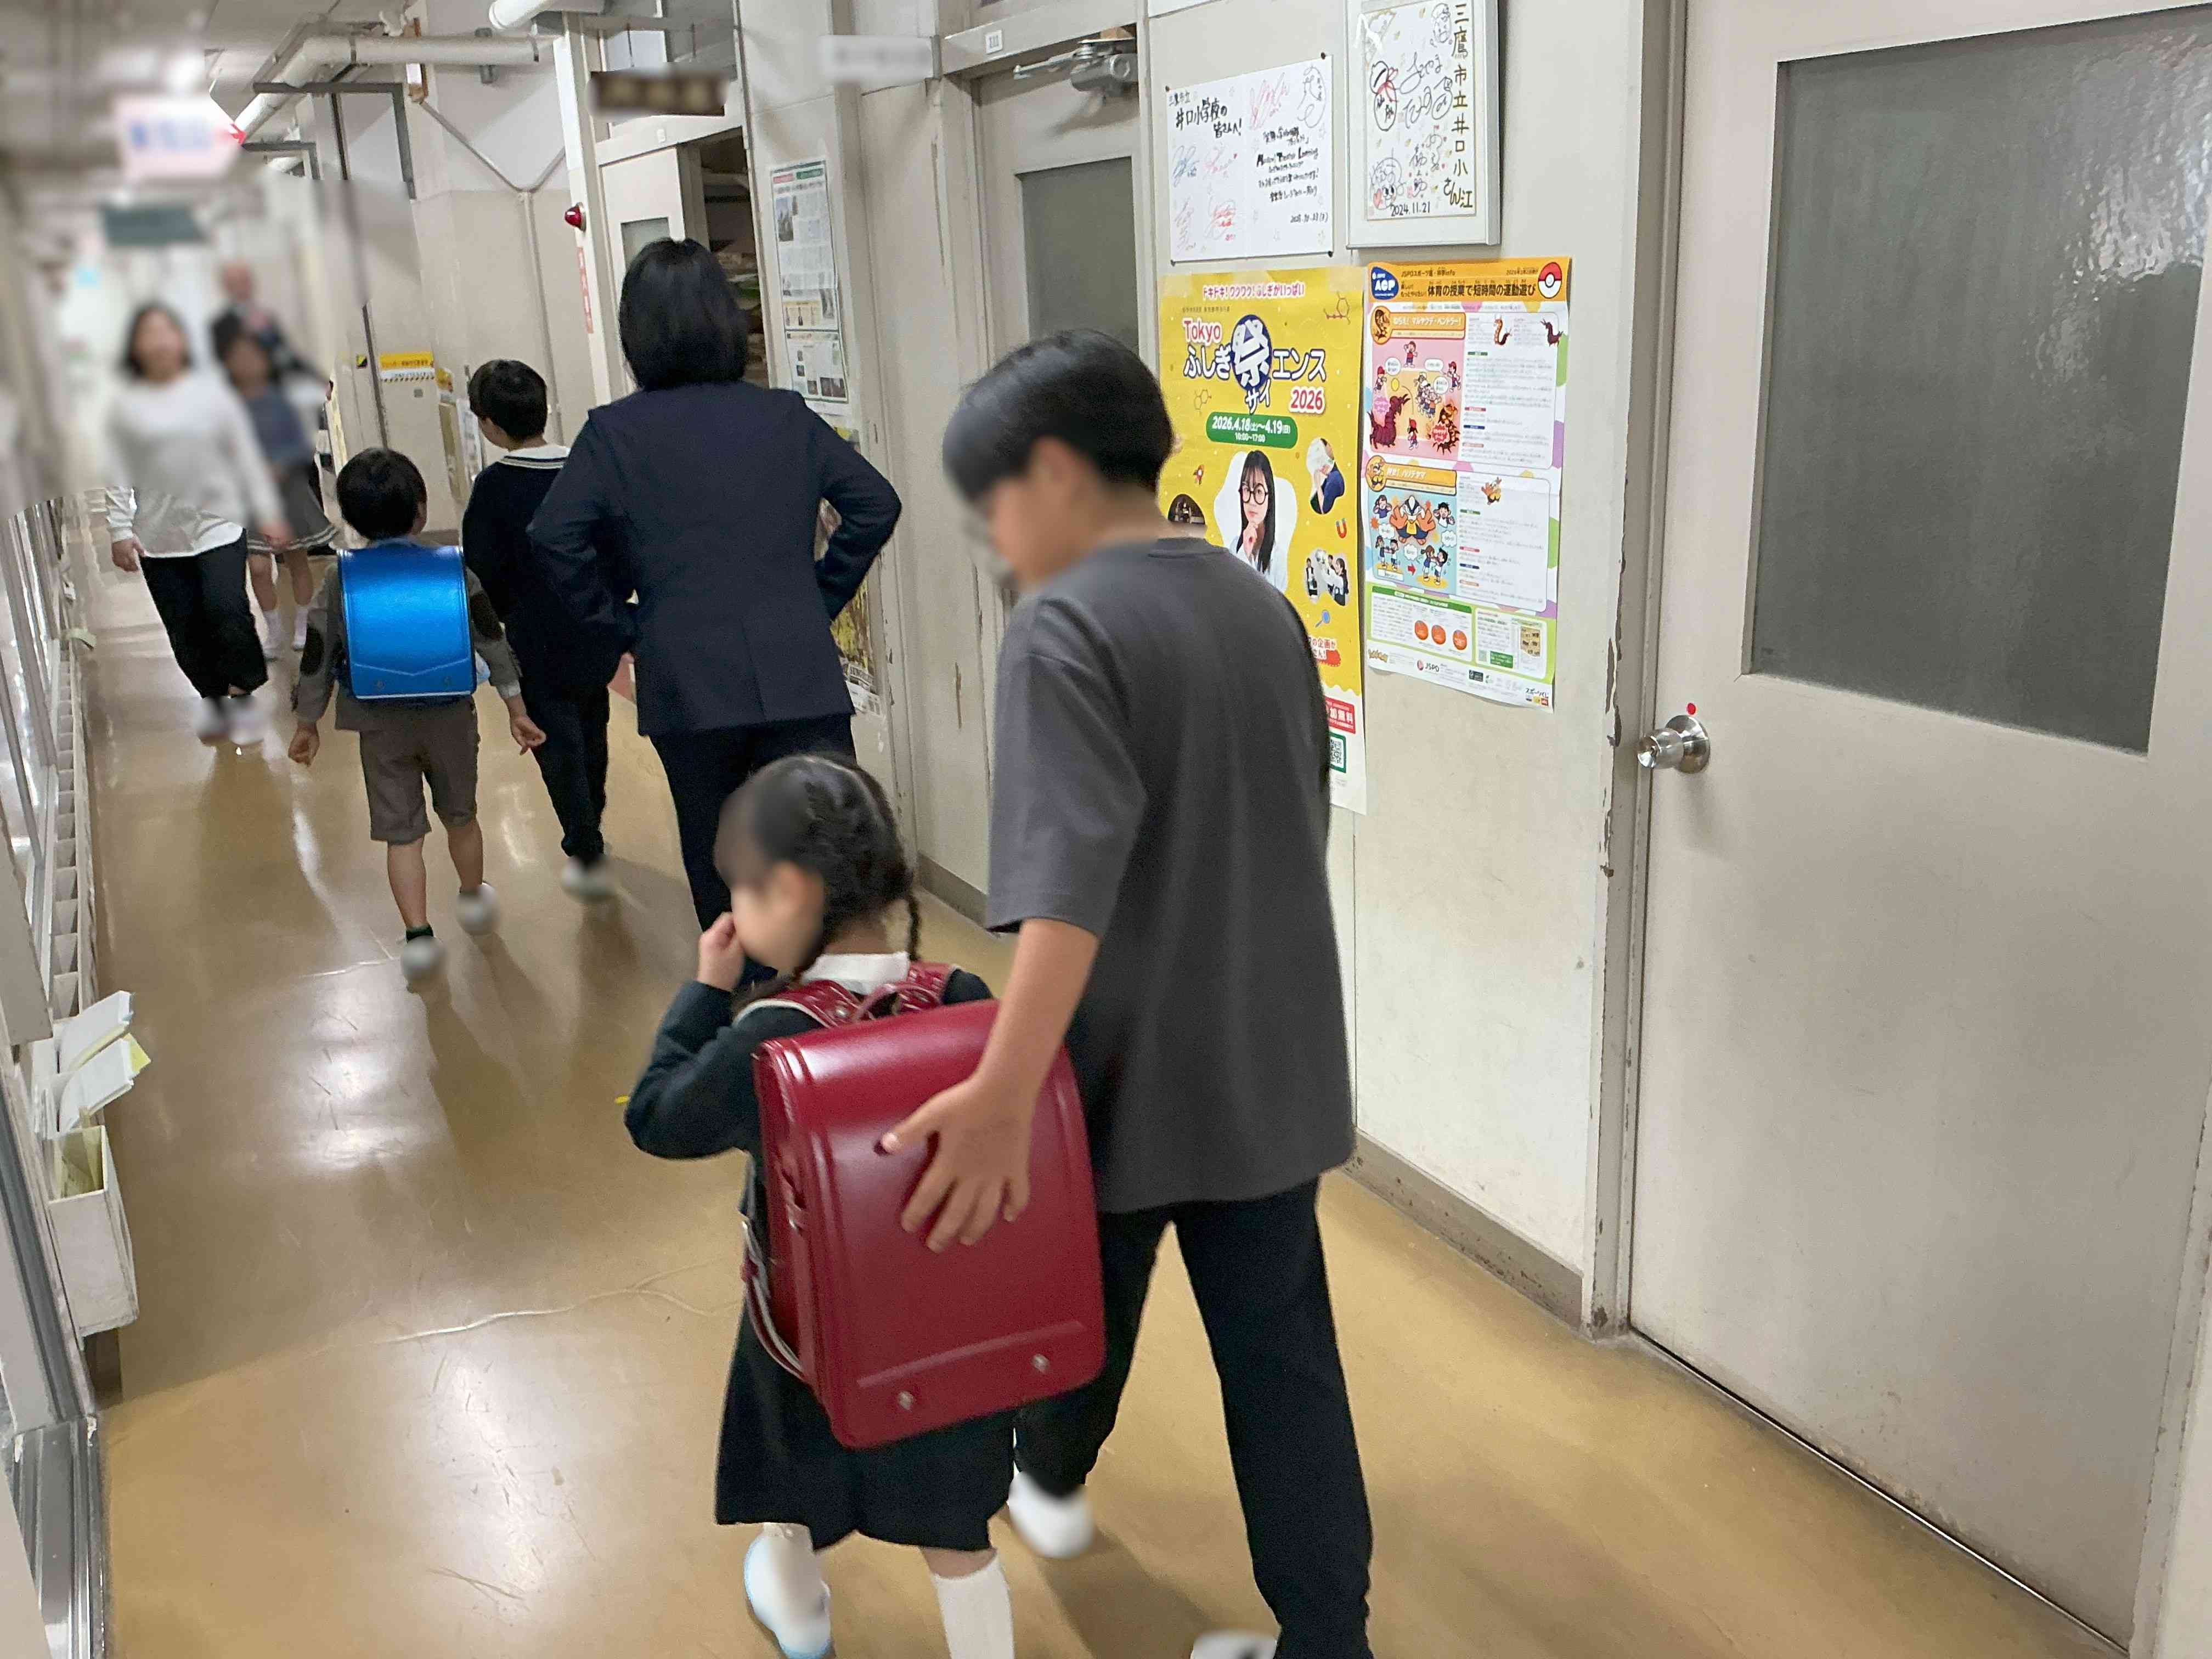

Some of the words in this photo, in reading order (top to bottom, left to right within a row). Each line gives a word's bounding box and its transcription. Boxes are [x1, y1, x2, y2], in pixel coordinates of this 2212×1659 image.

[1451, 3, 1470, 177] 三鷹市立井口小
[1391, 201, 1430, 217] 2024.11.21
[1427, 283, 1536, 297] 体育の授業で短時間の運動遊び
[1184, 320, 1221, 343] Tokyo
[1245, 380, 1271, 414] サイ
[1290, 390, 1323, 410] 2026
